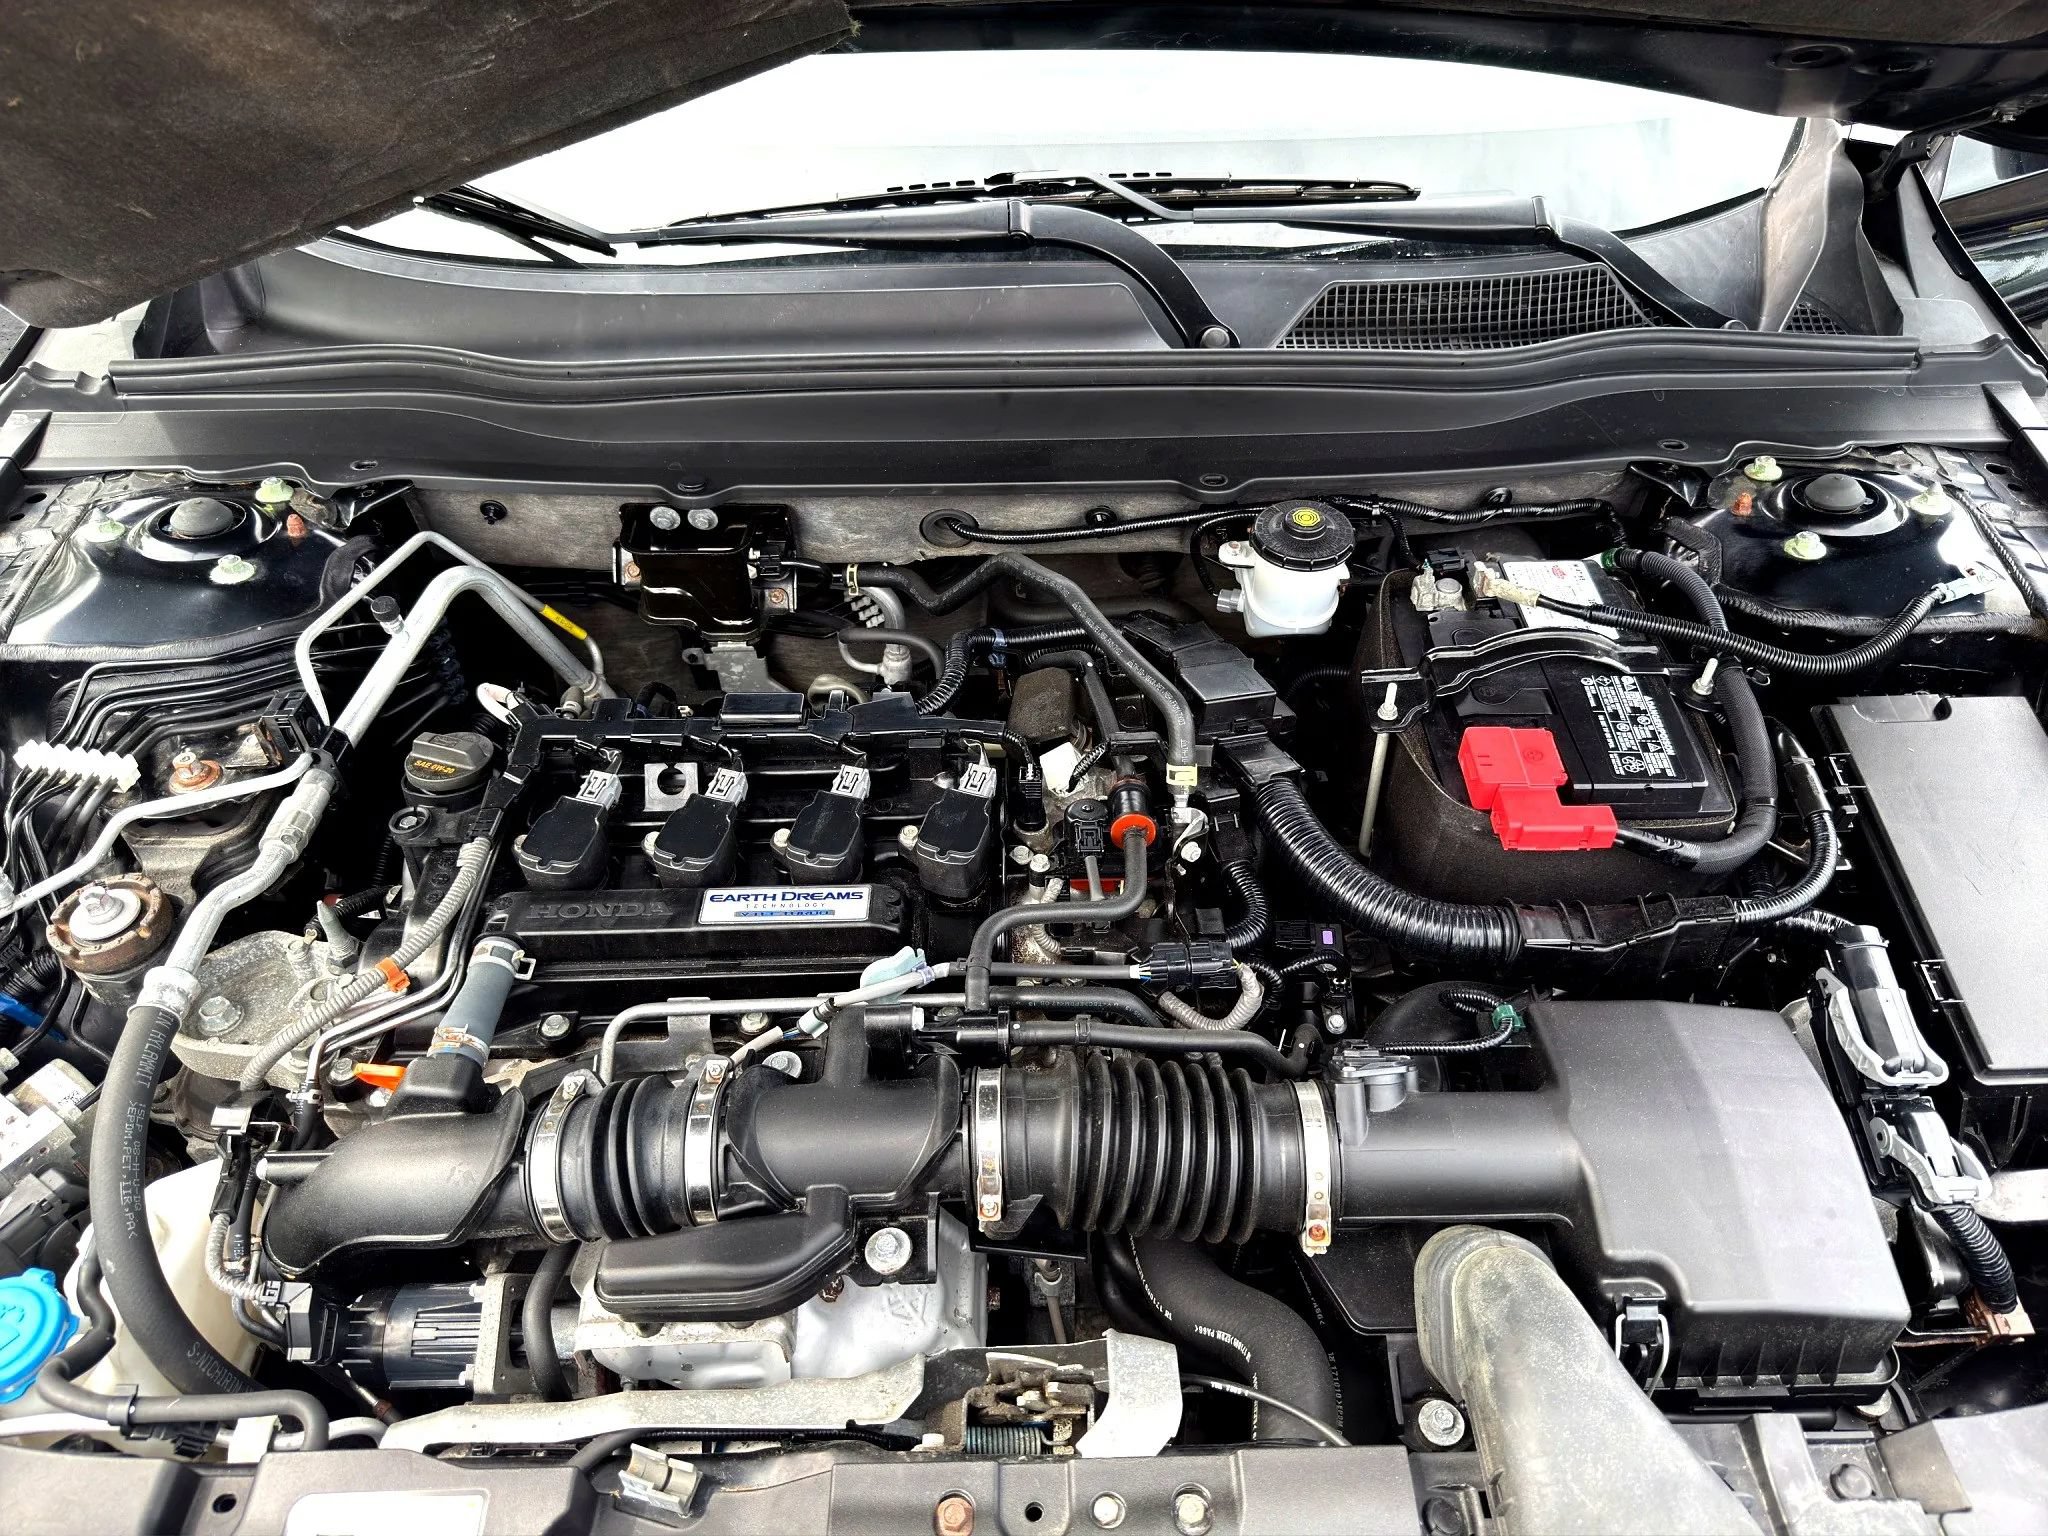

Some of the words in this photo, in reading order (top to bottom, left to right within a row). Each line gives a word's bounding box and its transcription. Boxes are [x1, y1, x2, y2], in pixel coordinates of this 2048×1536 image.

[414, 760, 433, 769] SAE
[709, 893, 777, 902] EARTH
[781, 892, 864, 901] DREAMS
[526, 901, 674, 919] HONDA
[136, 1029, 167, 1088] HYLAMMIT
